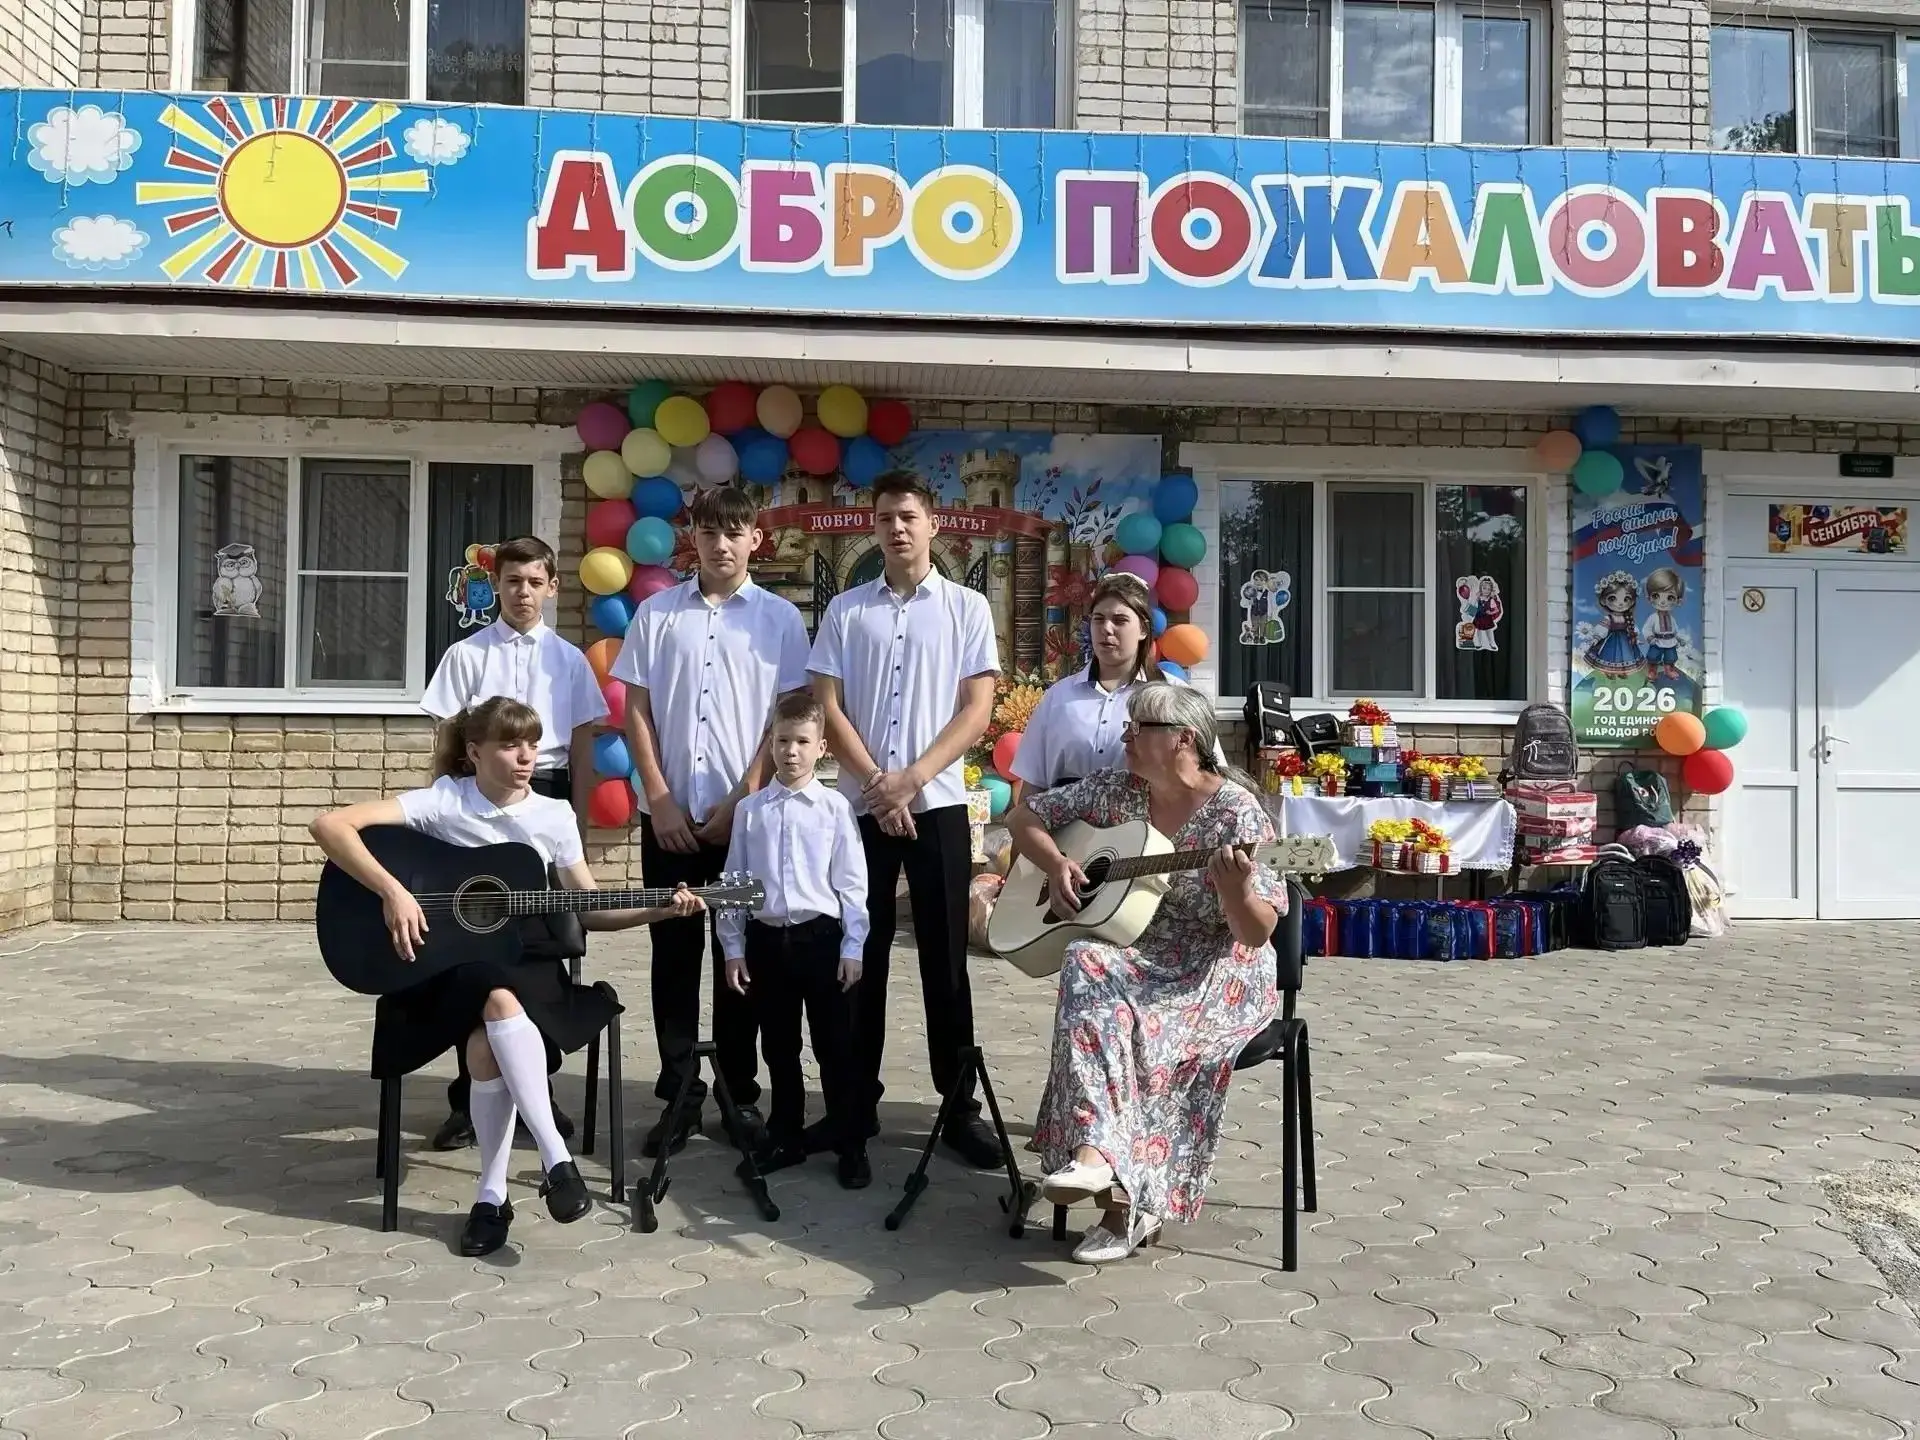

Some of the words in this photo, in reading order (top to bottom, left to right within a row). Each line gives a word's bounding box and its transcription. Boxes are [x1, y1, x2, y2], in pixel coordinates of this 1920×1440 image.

[528, 151, 1022, 280] ДОБРО
[1056, 170, 1920, 304] ПОЖАЛОВАТЬ
[811, 513, 863, 530] ДОБРО
[1591, 503, 1645, 529] Россия
[1810, 514, 1878, 542] СЕНТЯБРЯ
[1593, 686, 1676, 712] 2026
[1586, 727, 1639, 737] НАРОДОВ
[1594, 715, 1617, 726] ГОД
